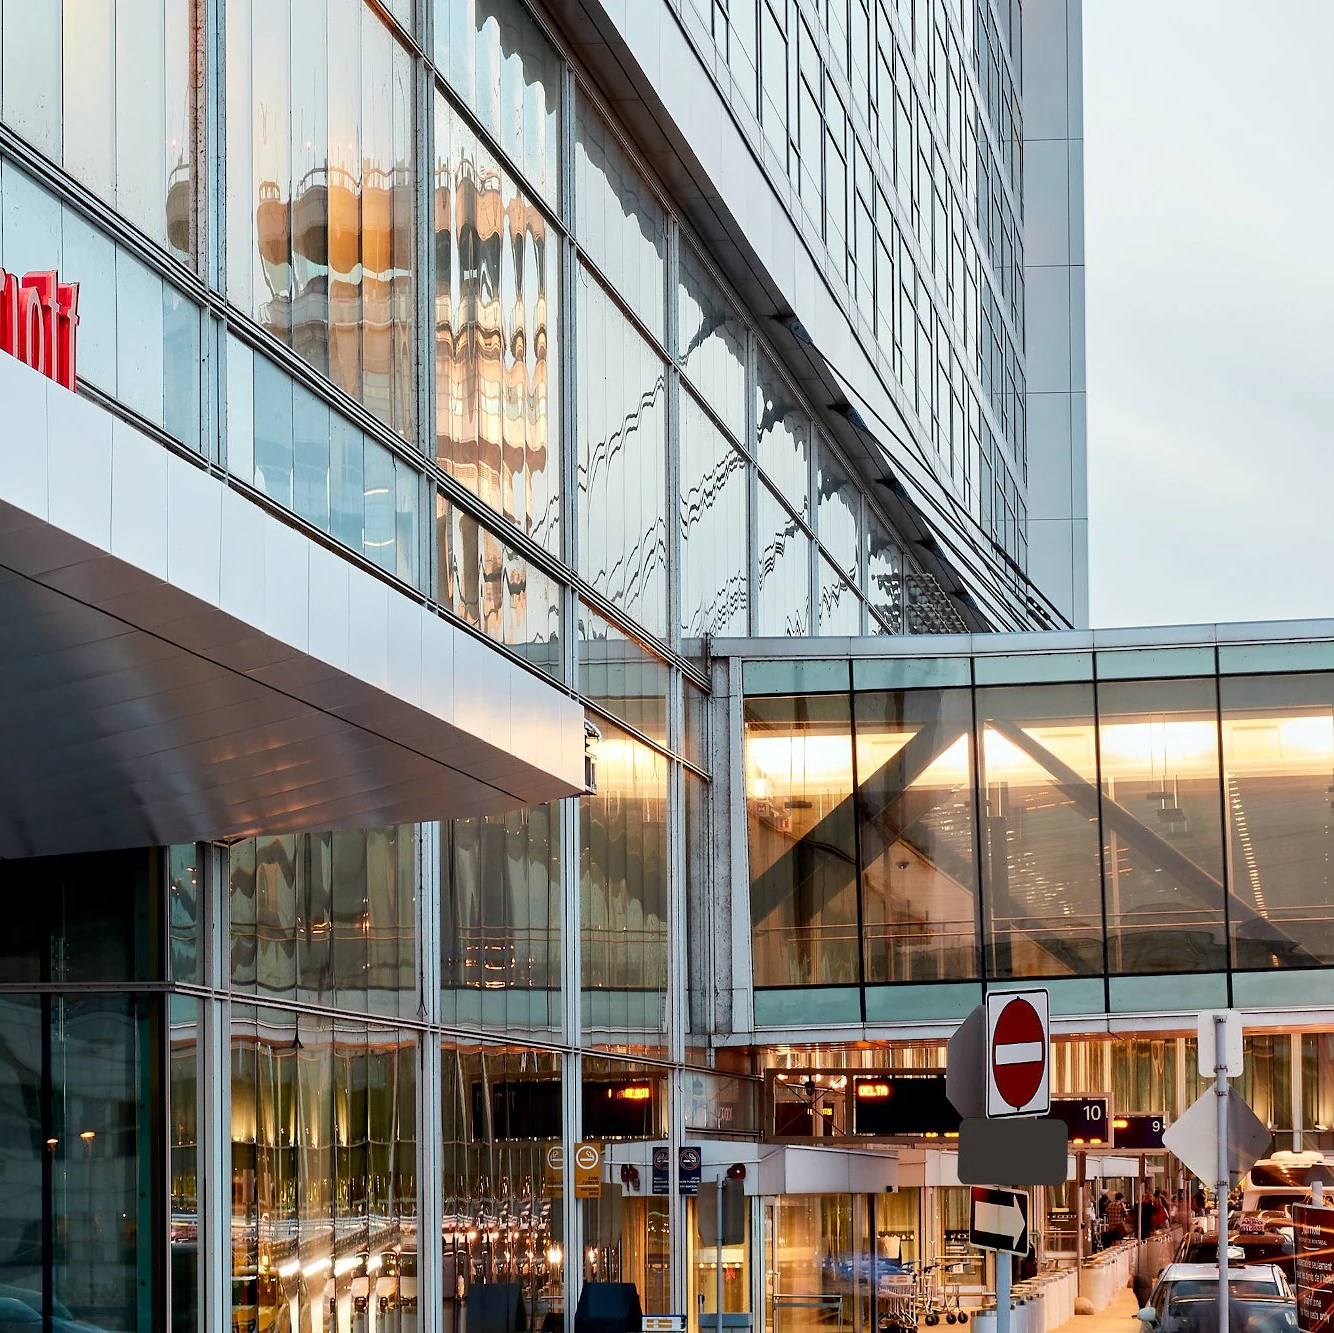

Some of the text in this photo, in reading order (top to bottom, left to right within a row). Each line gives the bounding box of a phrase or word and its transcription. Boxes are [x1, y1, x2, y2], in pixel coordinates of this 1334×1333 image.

[859, 1085, 889, 1097] DELTA
[1083, 1105, 1102, 1121] 10
[1152, 1121, 1160, 1132] 9
